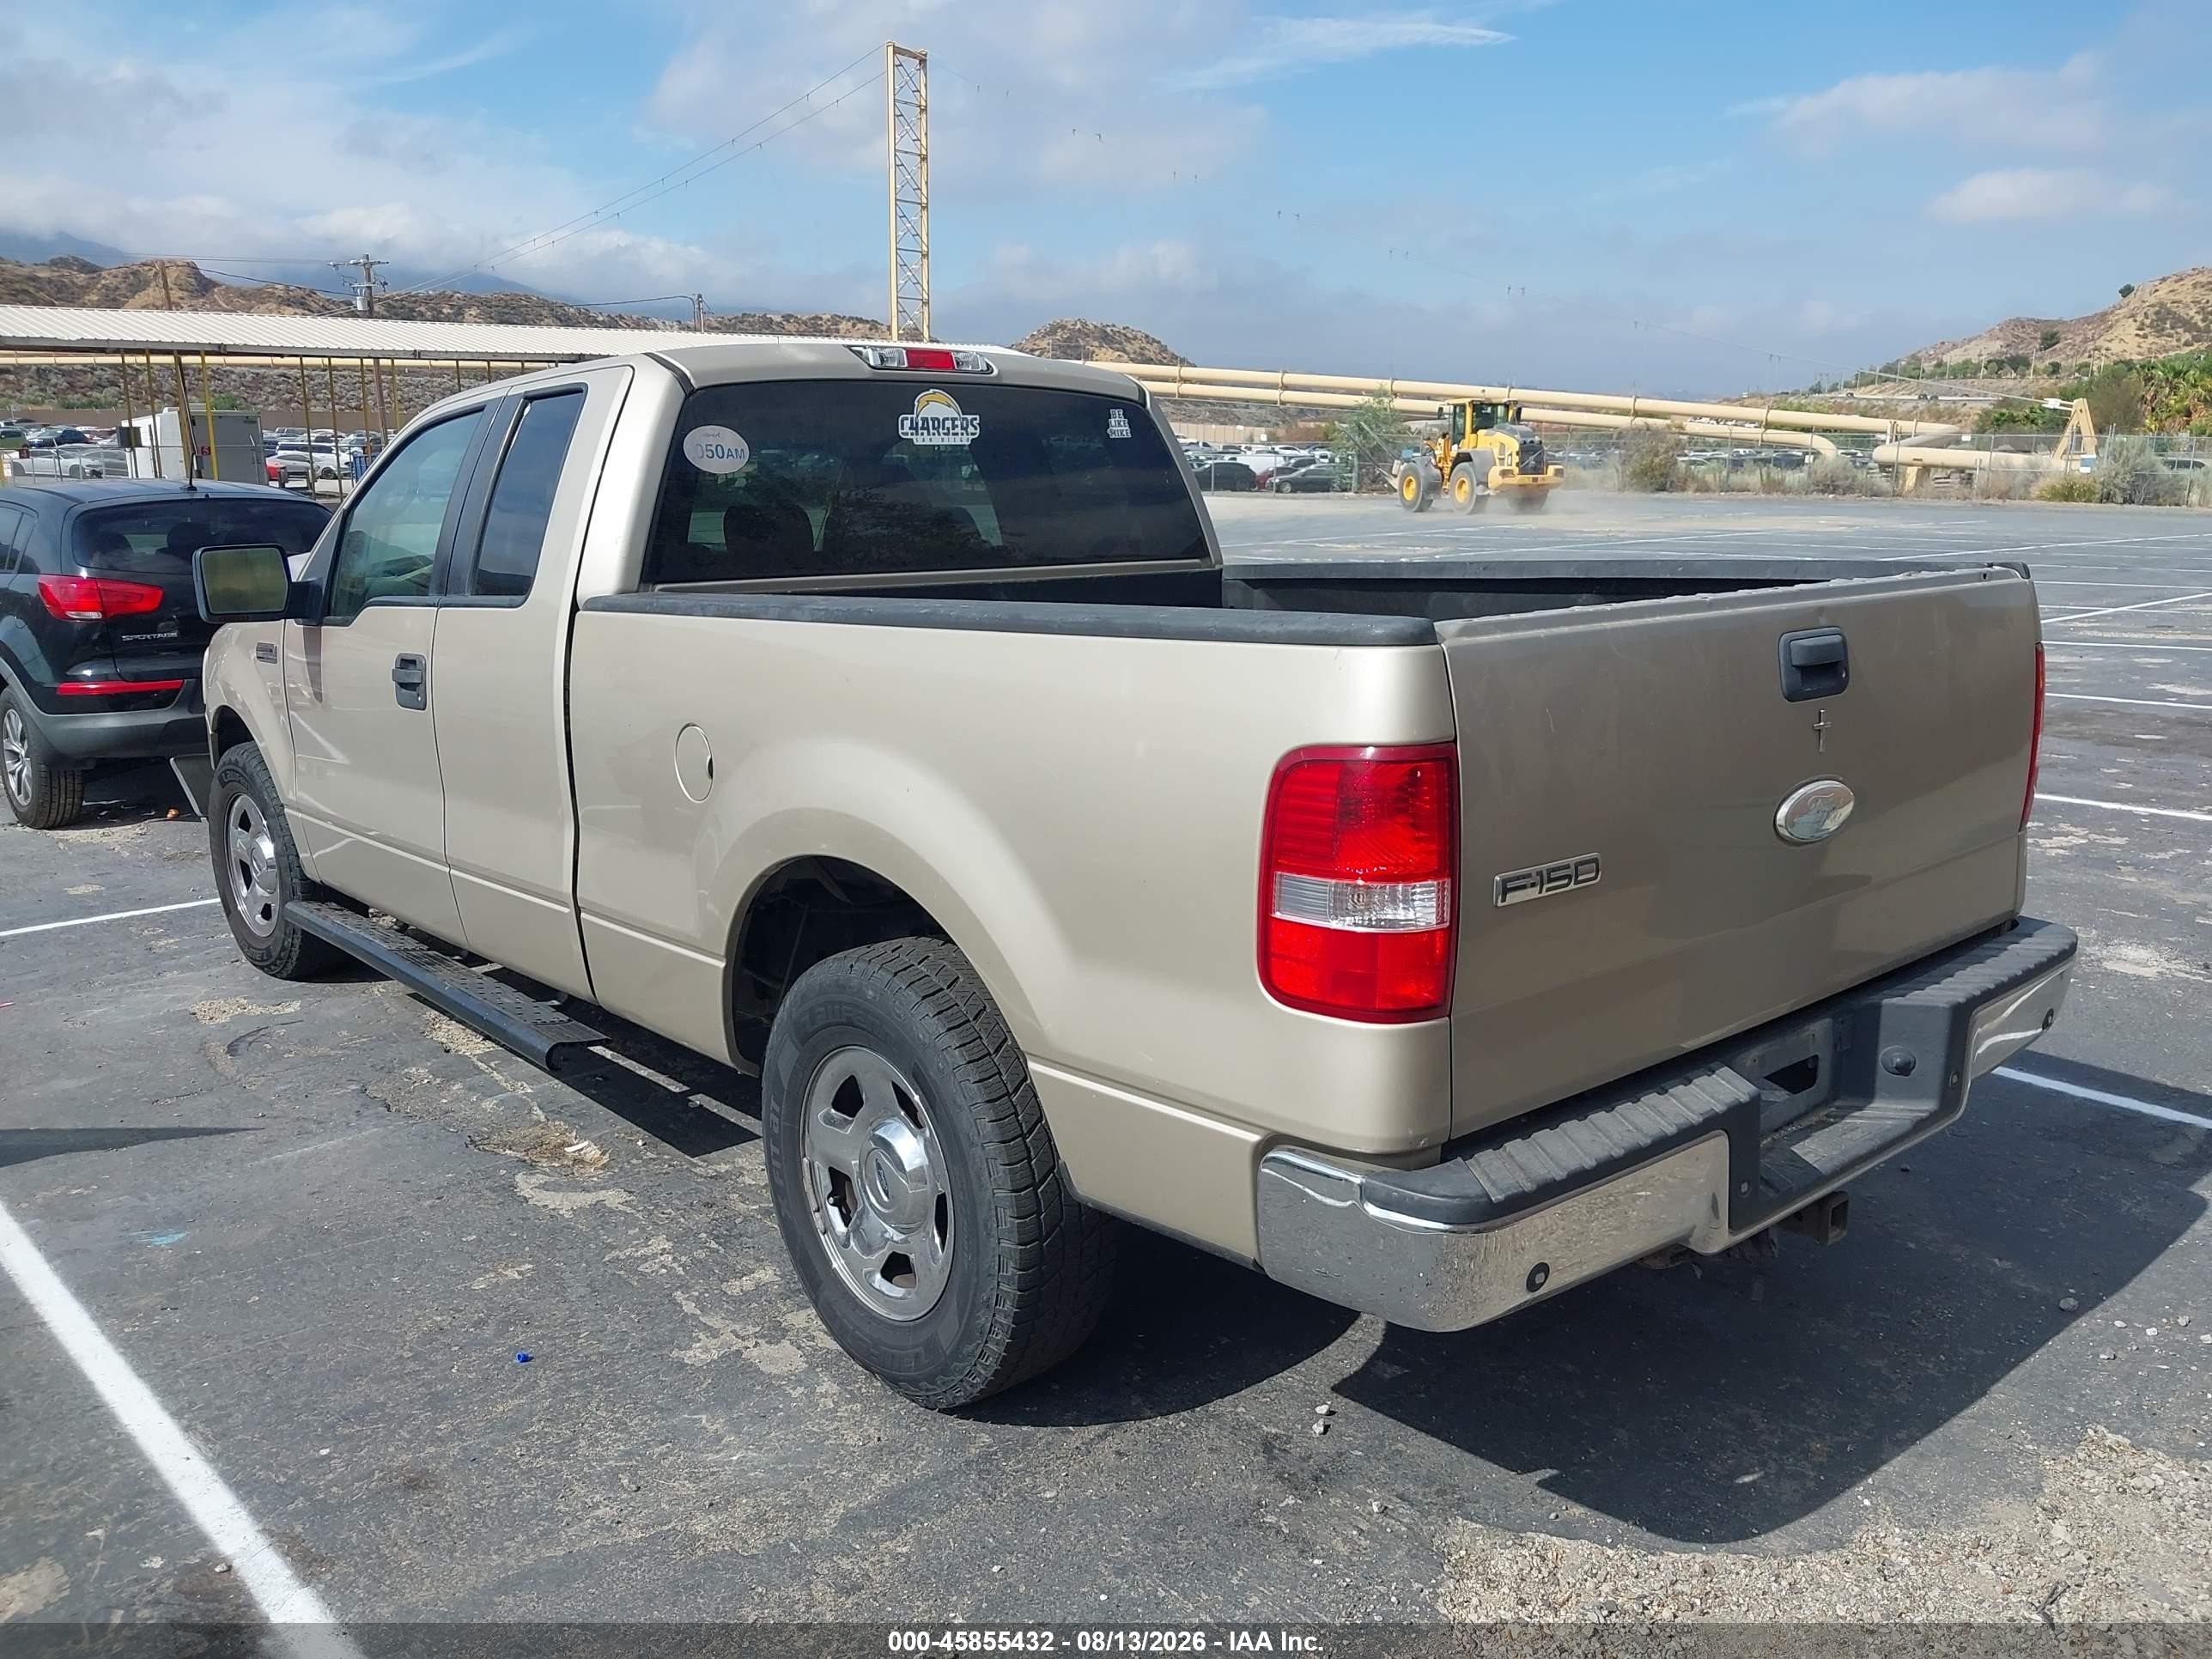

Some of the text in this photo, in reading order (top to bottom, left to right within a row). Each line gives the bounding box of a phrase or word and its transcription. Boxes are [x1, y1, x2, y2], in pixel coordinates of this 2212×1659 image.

[1111, 410, 1123, 419] BE
[900, 416, 979, 436] CHARGERS
[1109, 419, 1128, 428] LIKE
[1109, 428, 1131, 437] MIKE
